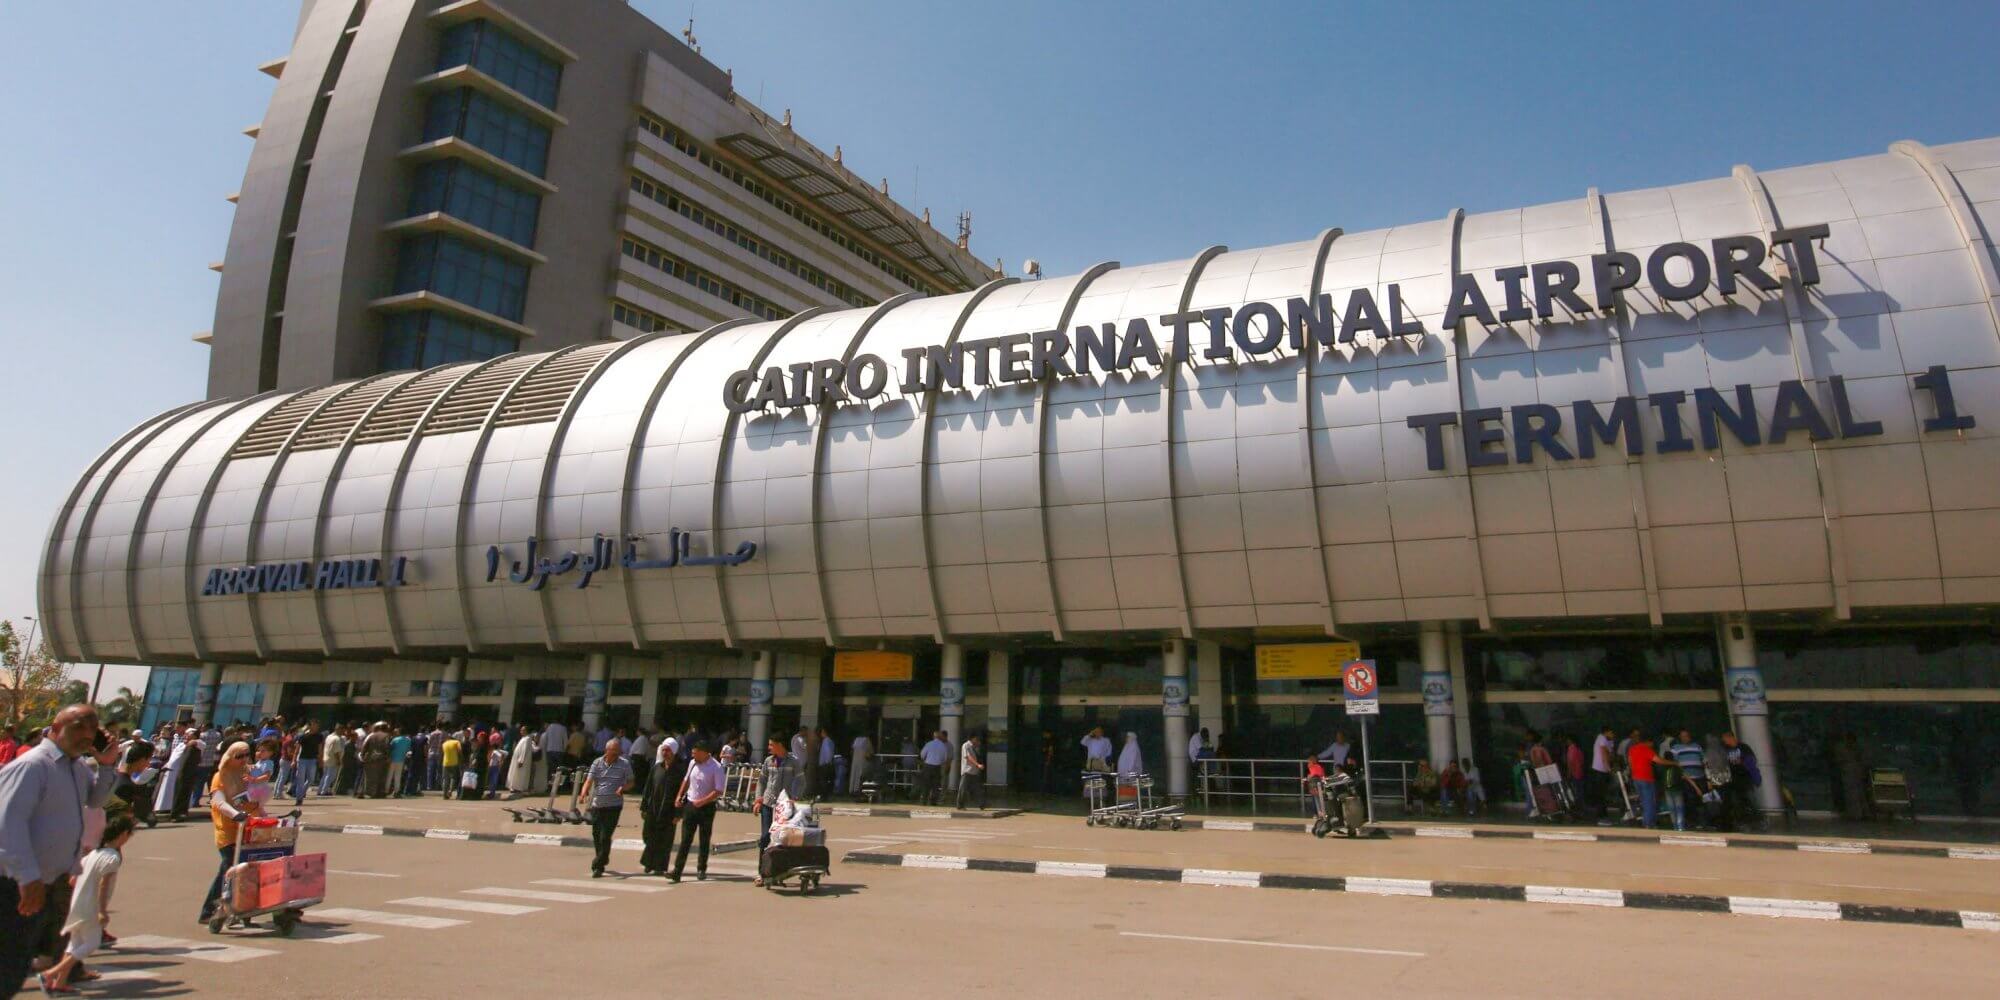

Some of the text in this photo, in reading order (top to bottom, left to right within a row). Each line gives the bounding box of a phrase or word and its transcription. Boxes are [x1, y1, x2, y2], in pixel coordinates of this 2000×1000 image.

[723, 223, 1830, 413] CAIRO INTERNATIONAL AIRPORT
[1407, 365, 1975, 471] TERMINAL 1
[203, 556, 407, 596] ARRIVAL HALL 1
[509, 532, 613, 590] الوصول
[1354, 668, 1368, 690] P
